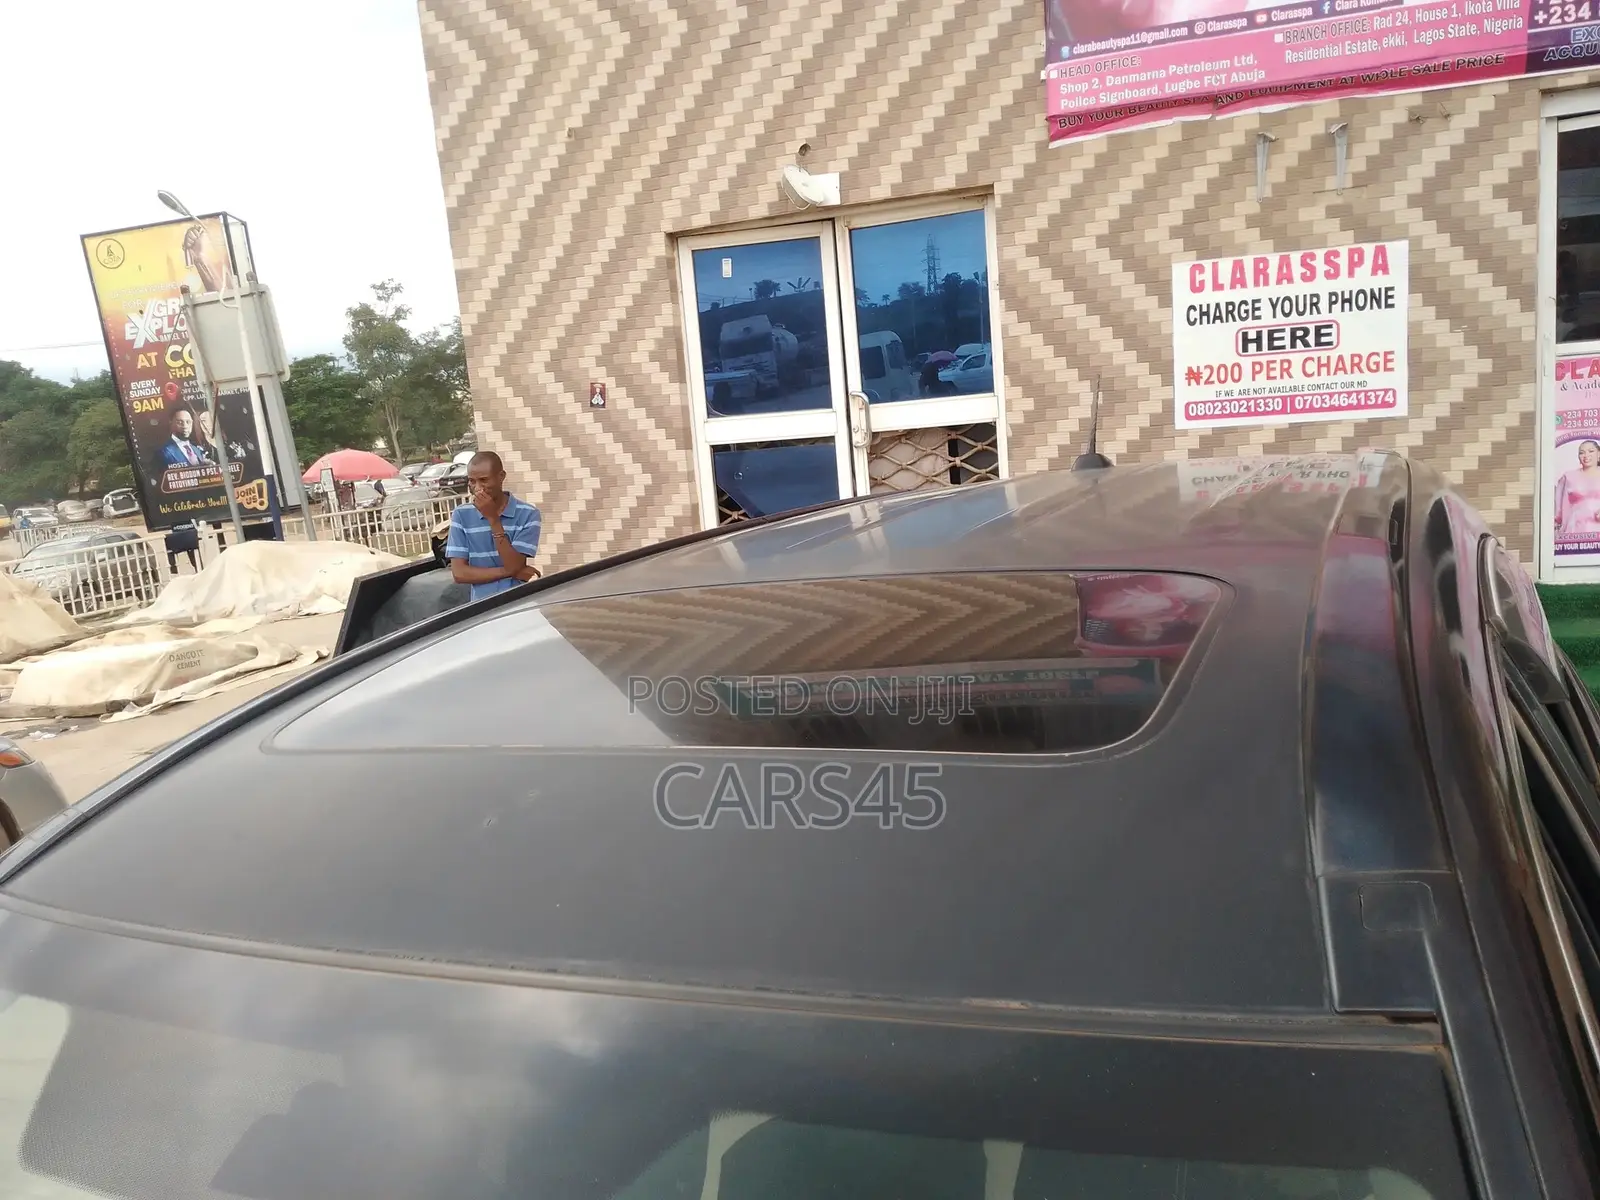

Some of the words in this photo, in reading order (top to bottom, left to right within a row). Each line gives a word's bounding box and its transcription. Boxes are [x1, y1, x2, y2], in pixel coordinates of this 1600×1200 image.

[1073, 27, 1188, 54] clarabeautyspa11@gmail.com
[1207, 17, 1248, 33] Clarasspa
[1271, 6, 1313, 22] Clarasspa
[1335, 0, 1358, 11] Clara
[1285, 25, 1327, 45] BRANCH
[1331, 17, 1371, 38] OFFICE:
[1373, 13, 1393, 31] Rad
[1396, 11, 1412, 27] 24,
[1415, 8, 1448, 24] House
[1451, 3, 1461, 19] 1,
[1465, 0, 1493, 16] Ikota
[1534, 2, 1592, 25] +234
[1285, 43, 1342, 64] Residential
[1345, 38, 1381, 55] Estate,
[1382, 31, 1408, 48] ekki,
[1413, 28, 1445, 45] Lagos
[1448, 22, 1480, 38] State,
[1484, 14, 1523, 35] Nigeria
[1543, 42, 1600, 61] ACQU
[1060, 64, 1091, 79] HEAD
[1095, 56, 1143, 72] OFFICE:
[1060, 82, 1089, 95] Shop
[1092, 78, 1102, 89] 2,
[1106, 69, 1166, 87] Danmarna
[1169, 58, 1231, 77] Petroleum
[1234, 53, 1258, 68] Ltd.
[1058, 114, 1085, 129] BUY
[1088, 108, 1124, 122] YOUR
[1215, 91, 1244, 106] AND
[1339, 75, 1356, 86] AT
[1412, 60, 1451, 76] SALE
[1456, 53, 1505, 70] PRICE
[1061, 97, 1096, 109] Police
[1099, 85, 1162, 104] Signboard,
[1165, 79, 1200, 94] Lugbe
[1204, 74, 1227, 87] FCT
[1230, 69, 1266, 84] Abuja
[1188, 244, 1390, 294] CLARASSPA
[1186, 298, 1262, 327] CHARGE
[1268, 292, 1322, 319] YOUR
[1328, 286, 1396, 314] PHONE
[1241, 324, 1334, 353] HERE
[137, 352, 158, 369] AT
[164, 342, 196, 368] CO
[1251, 358, 1294, 382] PER
[1301, 351, 1395, 379] CHARGE
[129, 386, 161, 399] SUNDAY
[130, 379, 156, 390] EVERY
[1215, 390, 1223, 398] IF
[1224, 389, 1234, 397] WE
[1238, 388, 1250, 396] ARE
[1252, 387, 1266, 395] NOT
[1268, 384, 1305, 394] AVAILABLE
[1307, 382, 1338, 392] CONTACT
[1340, 381, 1356, 389] OUR
[1357, 380, 1367, 388] MD
[132, 397, 165, 414] 9AM
[1188, 398, 1282, 417] 08023021330
[1294, 389, 1395, 410] 07034641374
[236, 486, 256, 499] JOIN
[159, 504, 172, 514] We
[174, 500, 207, 512] Celebrate
[1555, 543, 1563, 551] UY
[177, 660, 201, 670] CEMENT
